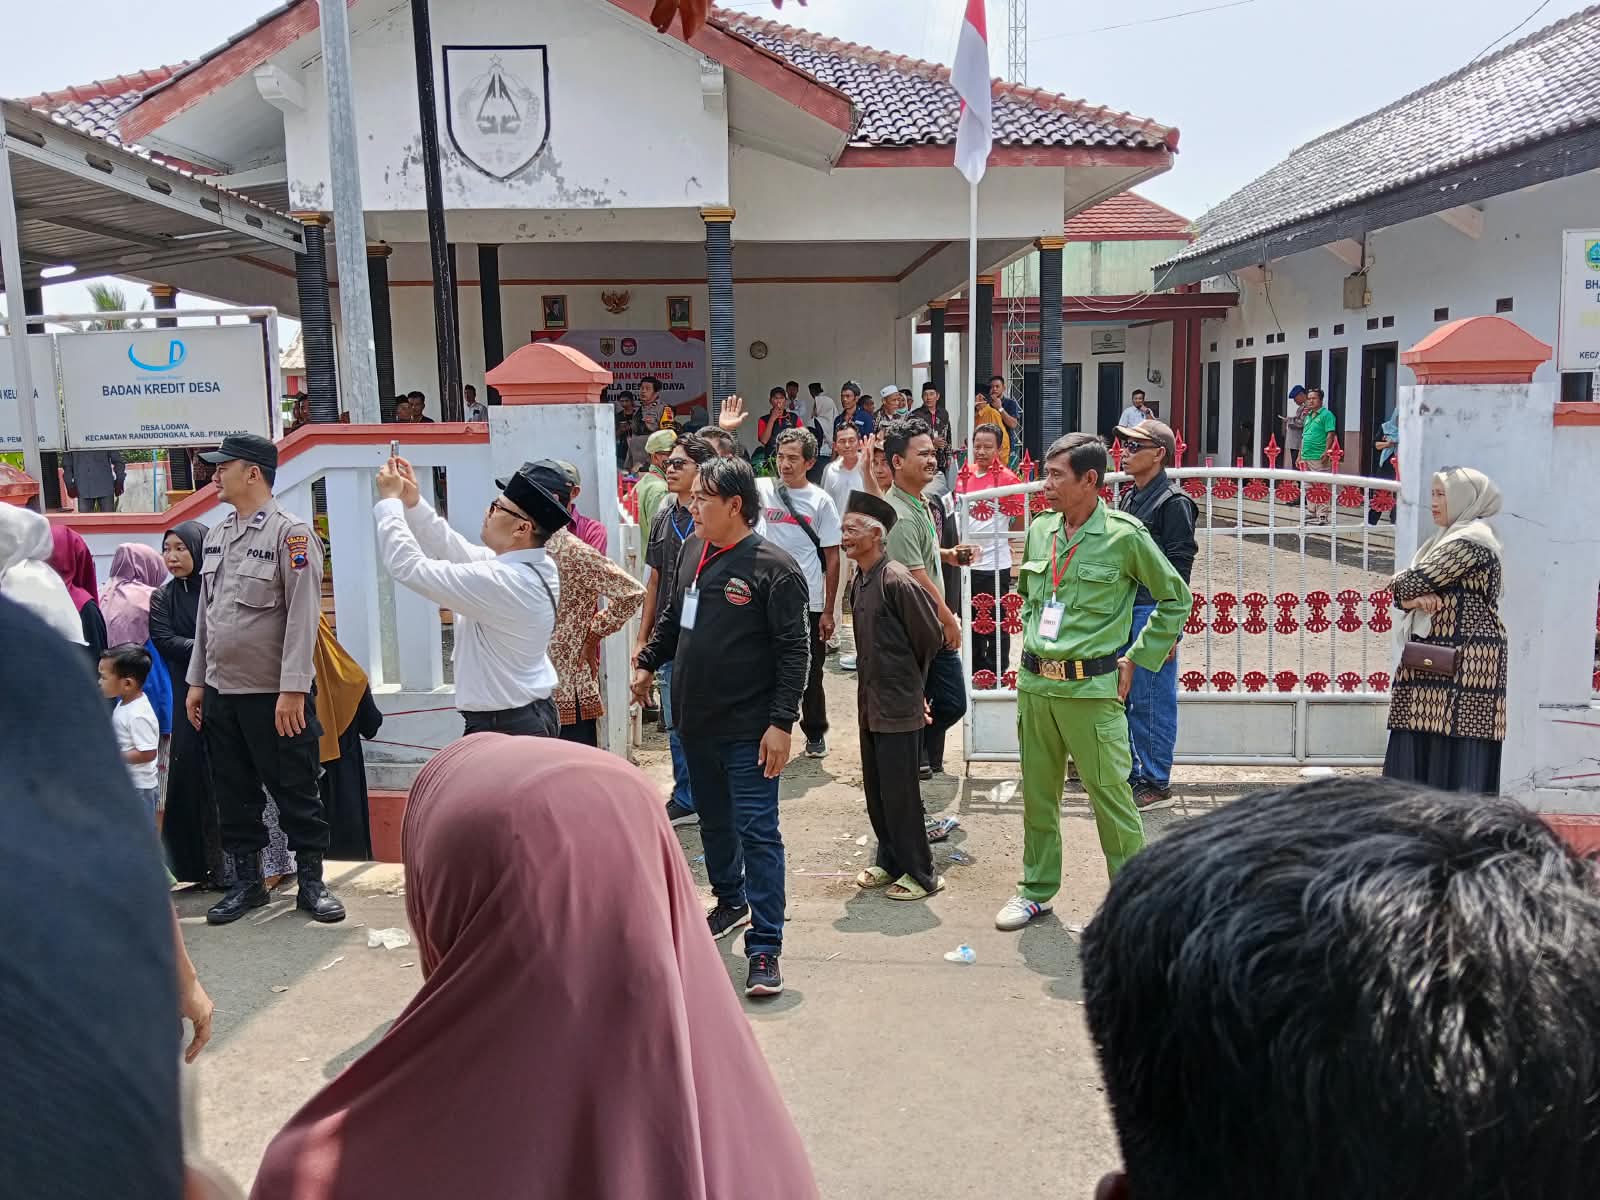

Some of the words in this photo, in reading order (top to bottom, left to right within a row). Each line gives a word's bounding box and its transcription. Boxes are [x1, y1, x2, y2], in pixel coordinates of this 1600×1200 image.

[1585, 279, 1600, 289] BH
[102, 384, 142, 397] BADAN
[144, 382, 185, 395] KREDIT
[189, 382, 220, 393] DESA
[161, 423, 190, 431] LODAYA
[85, 433, 128, 442] KECAMATAN
[129, 431, 188, 440] RANDUDONGKAL
[247, 549, 274, 560] POLRI
